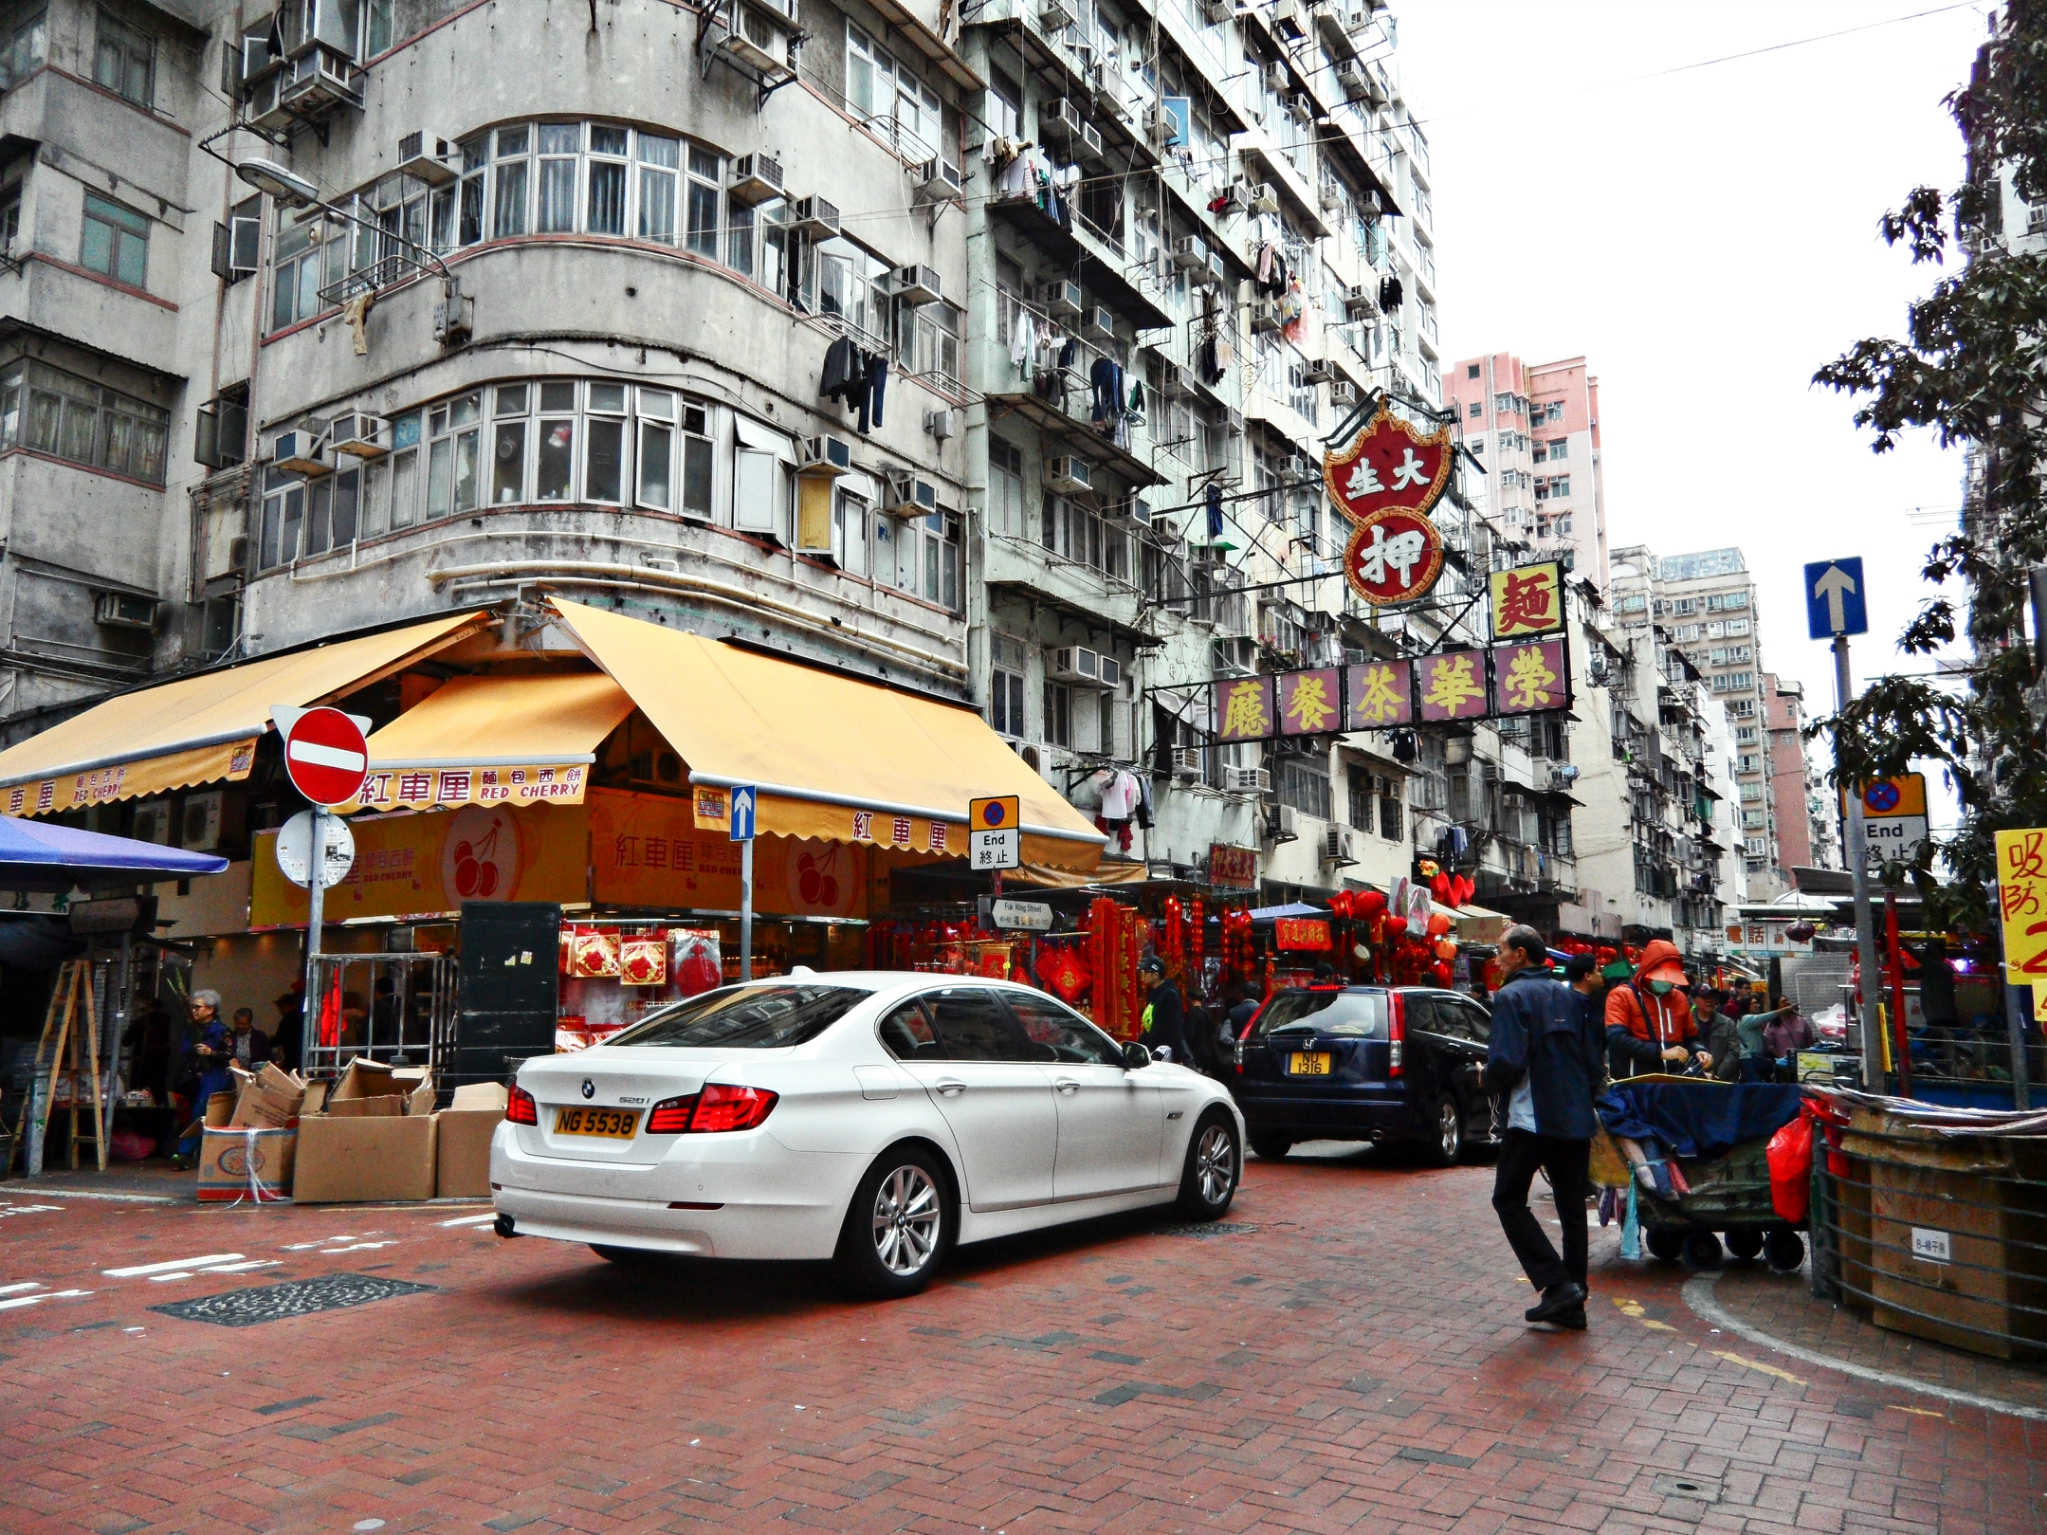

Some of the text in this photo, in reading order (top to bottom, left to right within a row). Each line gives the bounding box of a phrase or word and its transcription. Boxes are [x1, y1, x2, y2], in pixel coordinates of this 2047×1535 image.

[1358, 524, 1425, 588] 押
[482, 767, 583, 786] 麵包西餅
[73, 782, 122, 803] RED CHERRY
[358, 770, 472, 805] 紅車厘
[480, 783, 580, 800] RED CHERRY
[852, 811, 948, 850] 紅車厘
[1866, 823, 1904, 838] End
[983, 833, 1005, 846] End
[614, 832, 696, 872] 紅車厘
[978, 849, 1009, 865] 終止
[363, 870, 414, 883] RED CHERRY
[699, 863, 718, 875] RED
[1004, 902, 1042, 914] Fuk Wing Street
[1725, 925, 1764, 944] 電話
[1302, 1053, 1319, 1064] NU
[1298, 1063, 1322, 1074] 1316
[558, 1110, 635, 1136] NG 5538
